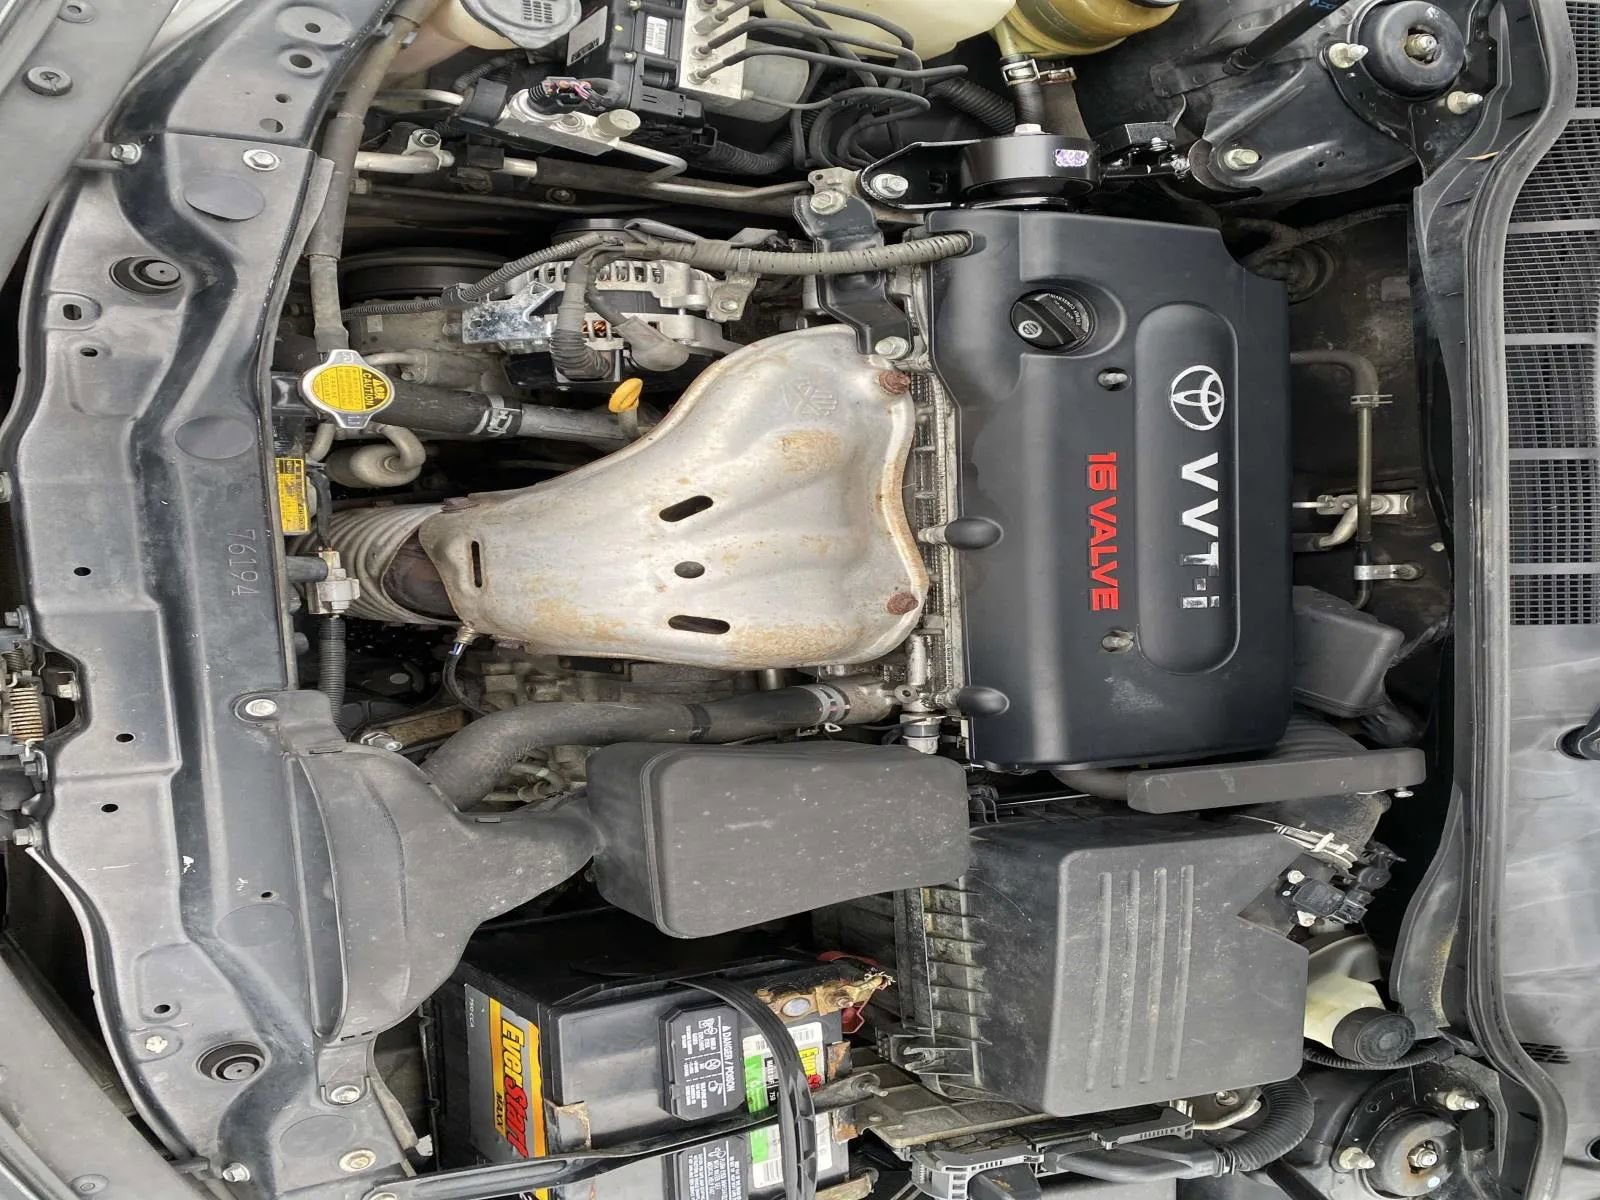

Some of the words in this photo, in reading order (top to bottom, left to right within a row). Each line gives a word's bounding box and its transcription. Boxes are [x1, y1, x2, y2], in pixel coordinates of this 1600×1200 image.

[362, 373, 375, 406] CAUTION
[1088, 451, 1118, 491] 16
[1180, 451, 1220, 609] VVT-i
[226, 529, 261, 597] 76194
[1088, 496, 1119, 612] VALVE
[722, 1031, 734, 1061] DANGER
[501, 1017, 529, 1159] EverStart
[724, 1066, 736, 1093] POISON
[495, 1091, 504, 1130] MAXX
